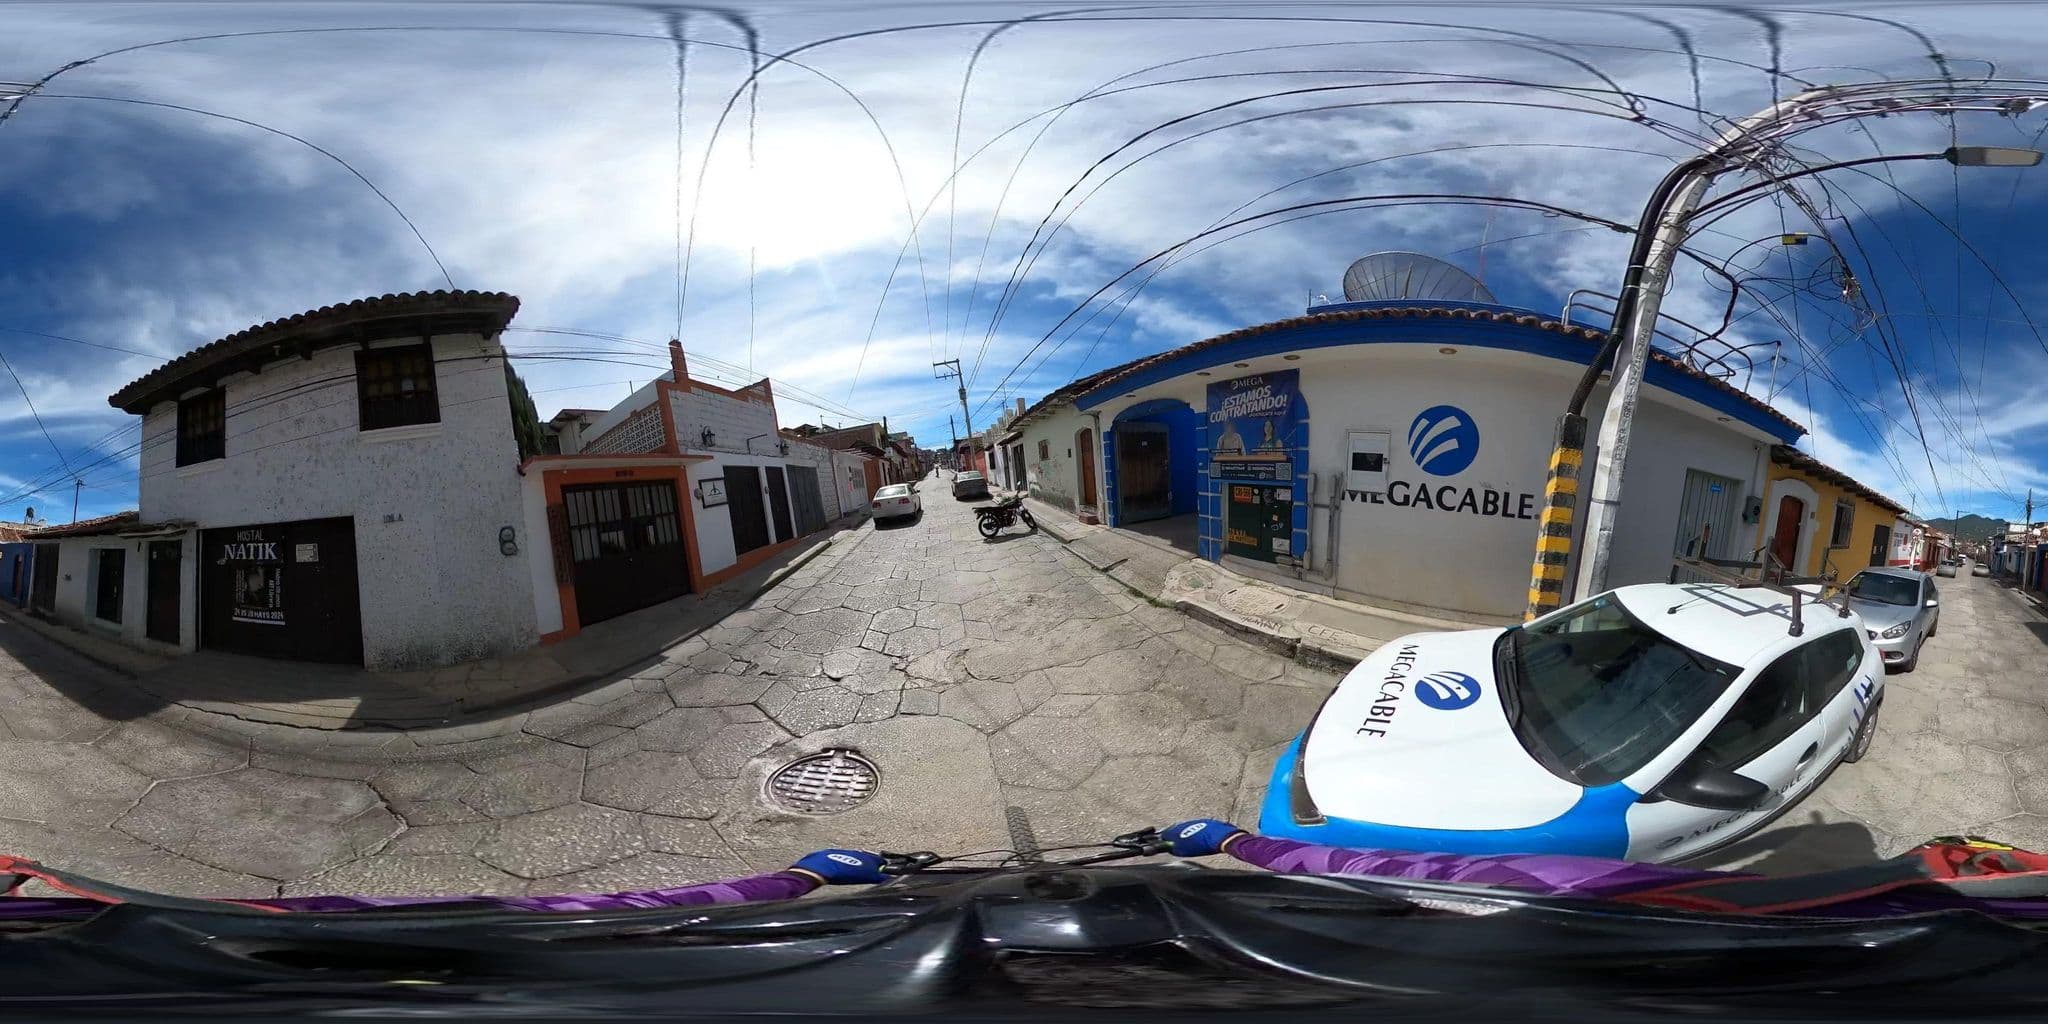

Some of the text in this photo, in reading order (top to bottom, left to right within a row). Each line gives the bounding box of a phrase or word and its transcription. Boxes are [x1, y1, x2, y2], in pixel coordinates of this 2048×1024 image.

[1239, 376, 1264, 388] MEGA
[1210, 394, 1288, 423] CONTRATANDO!
[1221, 385, 1272, 411] ¡ESTAMOS
[236, 529, 264, 542] HOSTAL
[224, 542, 278, 560] NATIK
[1357, 644, 1420, 738] MEGACABLE
